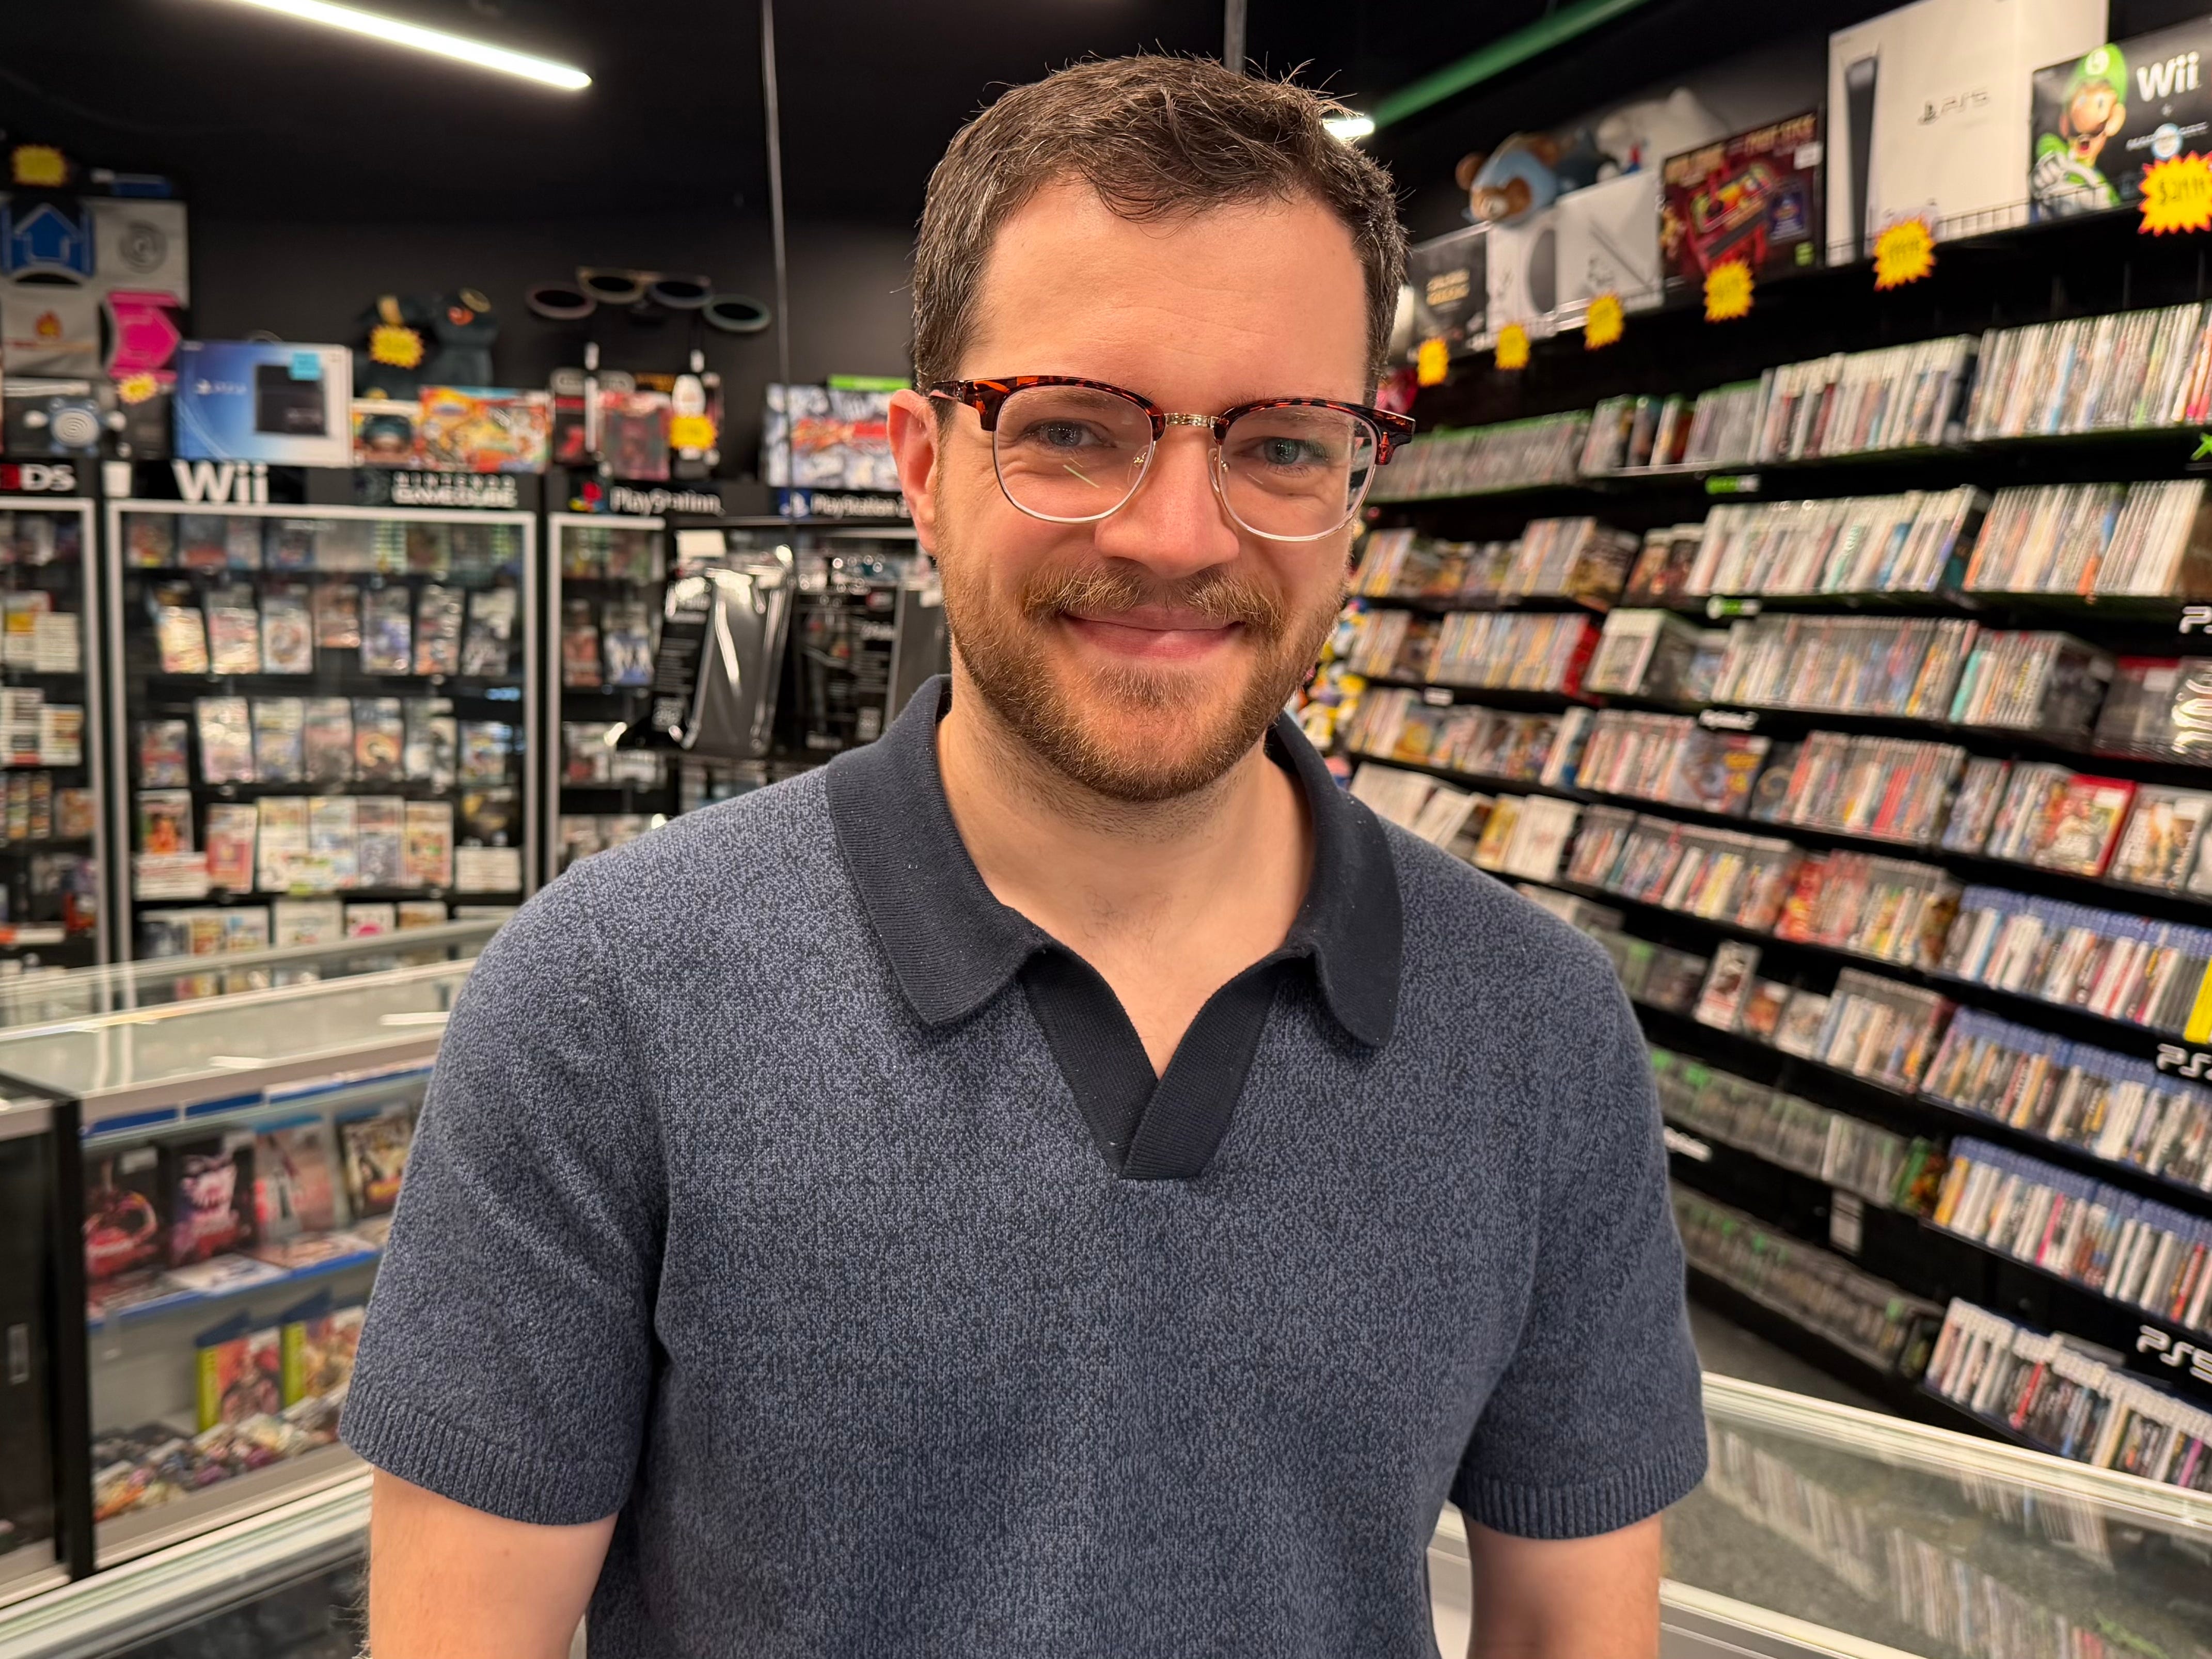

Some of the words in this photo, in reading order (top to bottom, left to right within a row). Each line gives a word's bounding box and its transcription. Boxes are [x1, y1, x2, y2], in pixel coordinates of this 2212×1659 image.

[2136, 51, 2200, 102] Wii
[171, 459, 269, 504] Wii
[610, 486, 722, 516] PlayStation
[2156, 1043, 2212, 1081] PS
